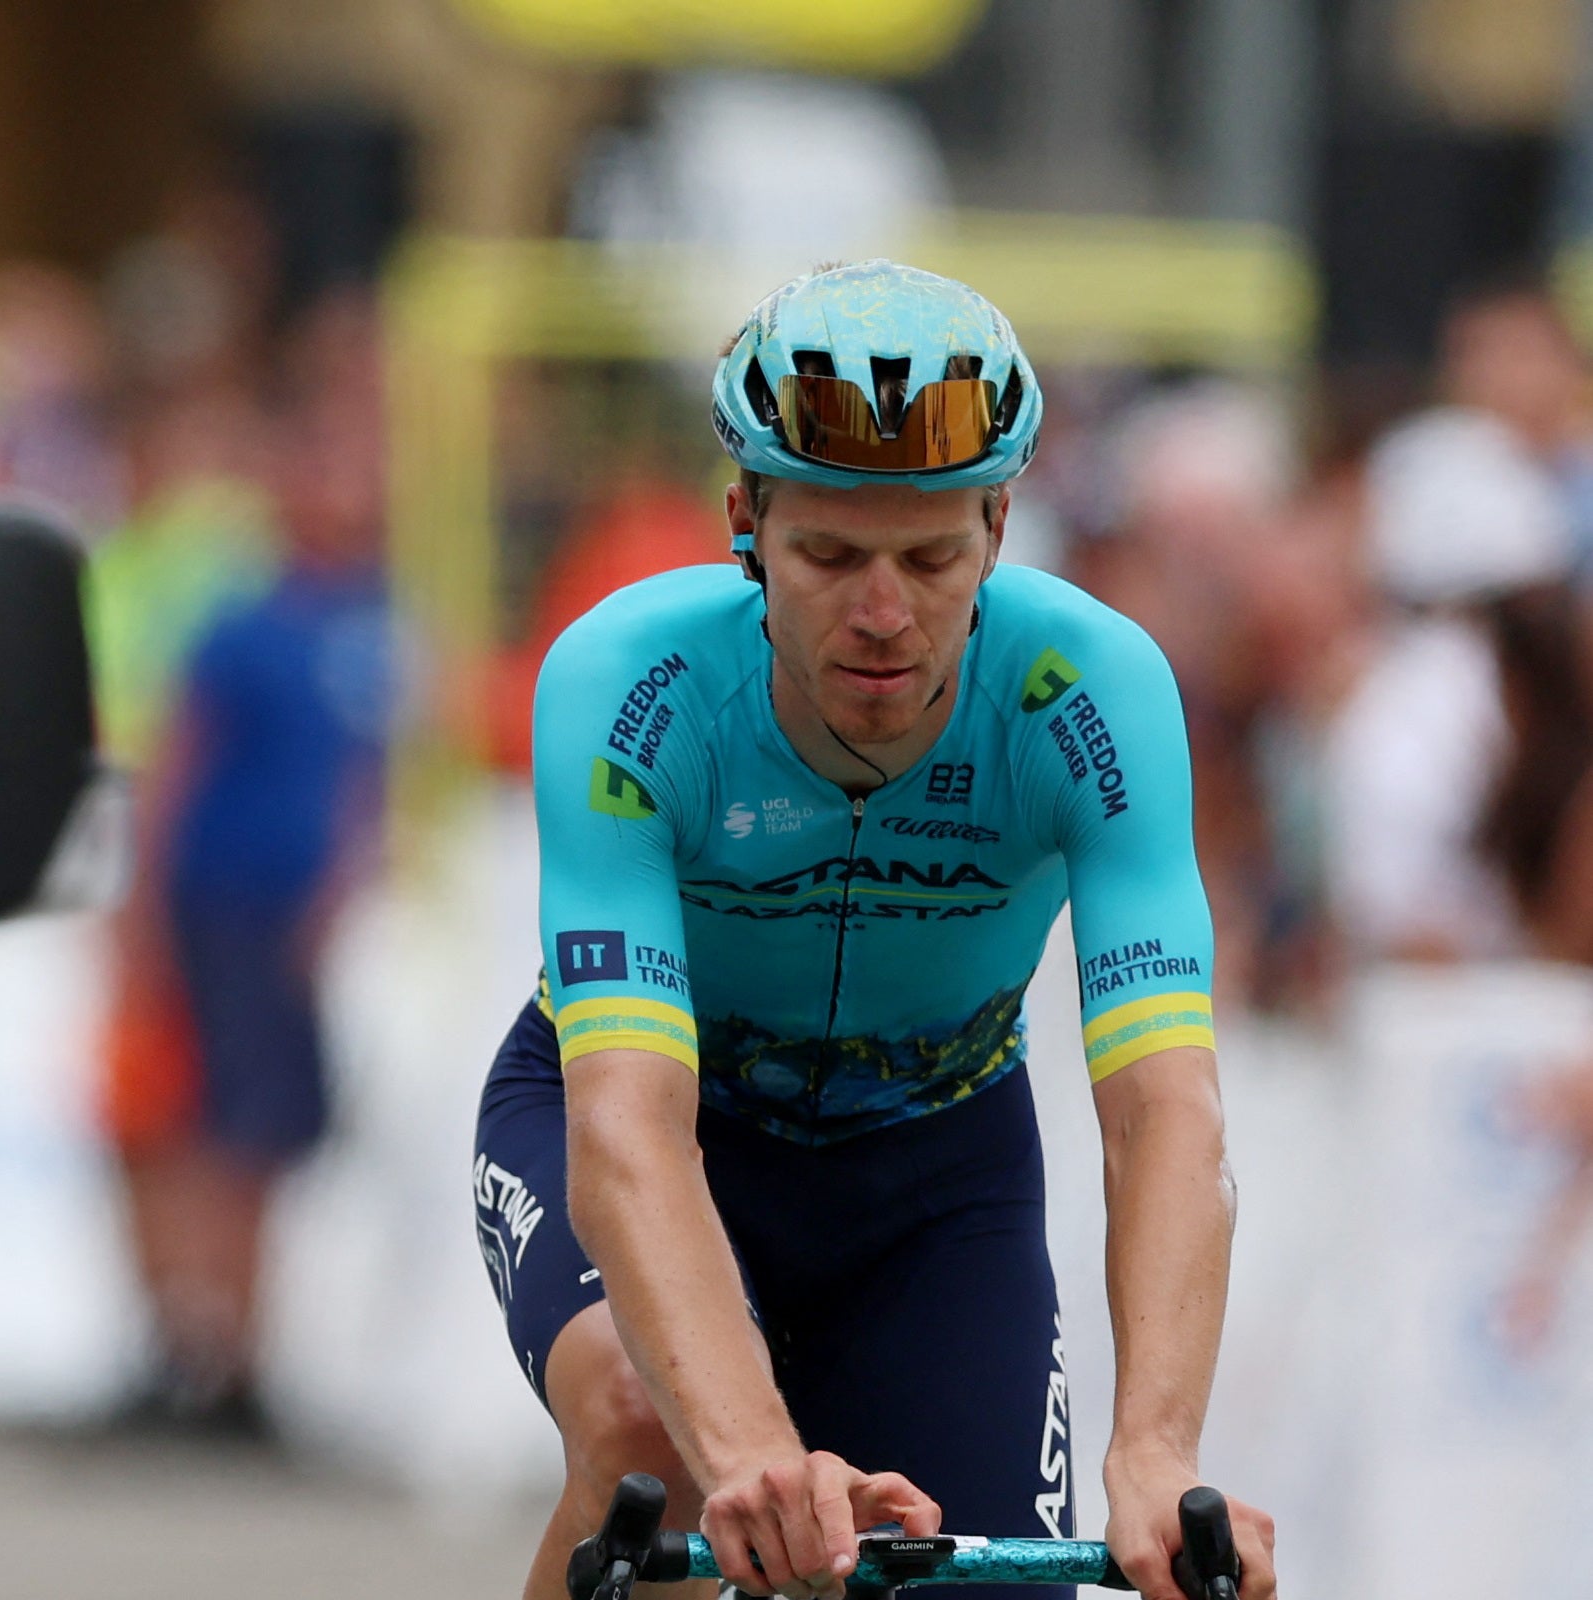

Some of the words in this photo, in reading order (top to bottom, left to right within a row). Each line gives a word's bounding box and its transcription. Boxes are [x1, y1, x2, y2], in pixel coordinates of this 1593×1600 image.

[608, 652, 690, 757] FREEDOM
[636, 703, 675, 771] BROKER
[1047, 714, 1089, 785] BROKER
[1065, 691, 1129, 821] FREEDOM
[927, 763, 976, 796] B3
[762, 798, 791, 811] UCI
[764, 807, 815, 823] WORLD
[764, 821, 802, 835] TEAM
[572, 944, 606, 969] IT
[1084, 938, 1163, 982] ITALIAN
[1086, 957, 1200, 1001] TRATTORIA
[890, 1541, 935, 1551] GARMIN
